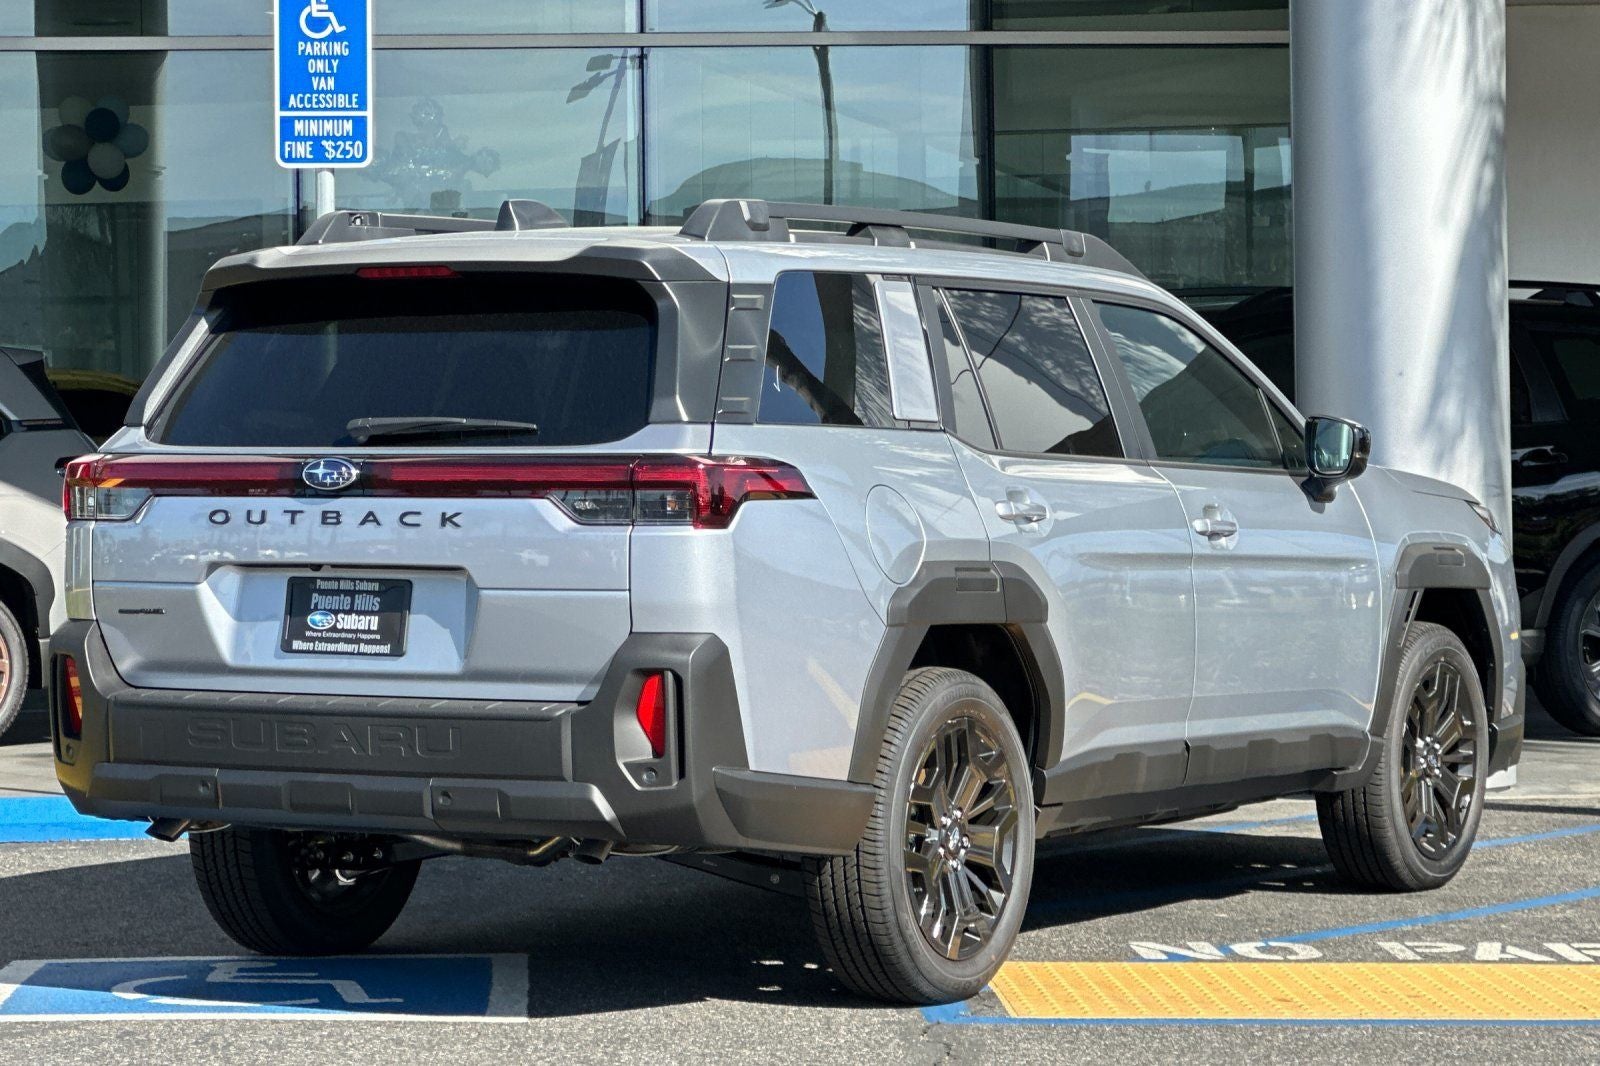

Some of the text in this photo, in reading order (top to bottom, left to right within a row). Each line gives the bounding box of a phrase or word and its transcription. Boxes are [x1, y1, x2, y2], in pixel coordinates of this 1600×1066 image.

[298, 41, 350, 56] PARKING
[308, 59, 339, 73] ONLY
[312, 76, 335, 91] VAN
[288, 93, 359, 108] ACCESSIBLE
[294, 119, 353, 137] MINIMUM
[284, 140, 363, 160] FINE $250
[208, 509, 463, 528] OUTBACK
[316, 579, 379, 591] Puente Hills Subaru
[310, 592, 381, 611] Puente Hills
[336, 613, 379, 631] Subaru
[322, 631, 356, 640] Extraordinary
[357, 632, 381, 640] Happens
[292, 640, 391, 654] Where Extraordinary Happens!
[186, 717, 463, 759] SUBARU
[1129, 941, 1323, 961] NO
